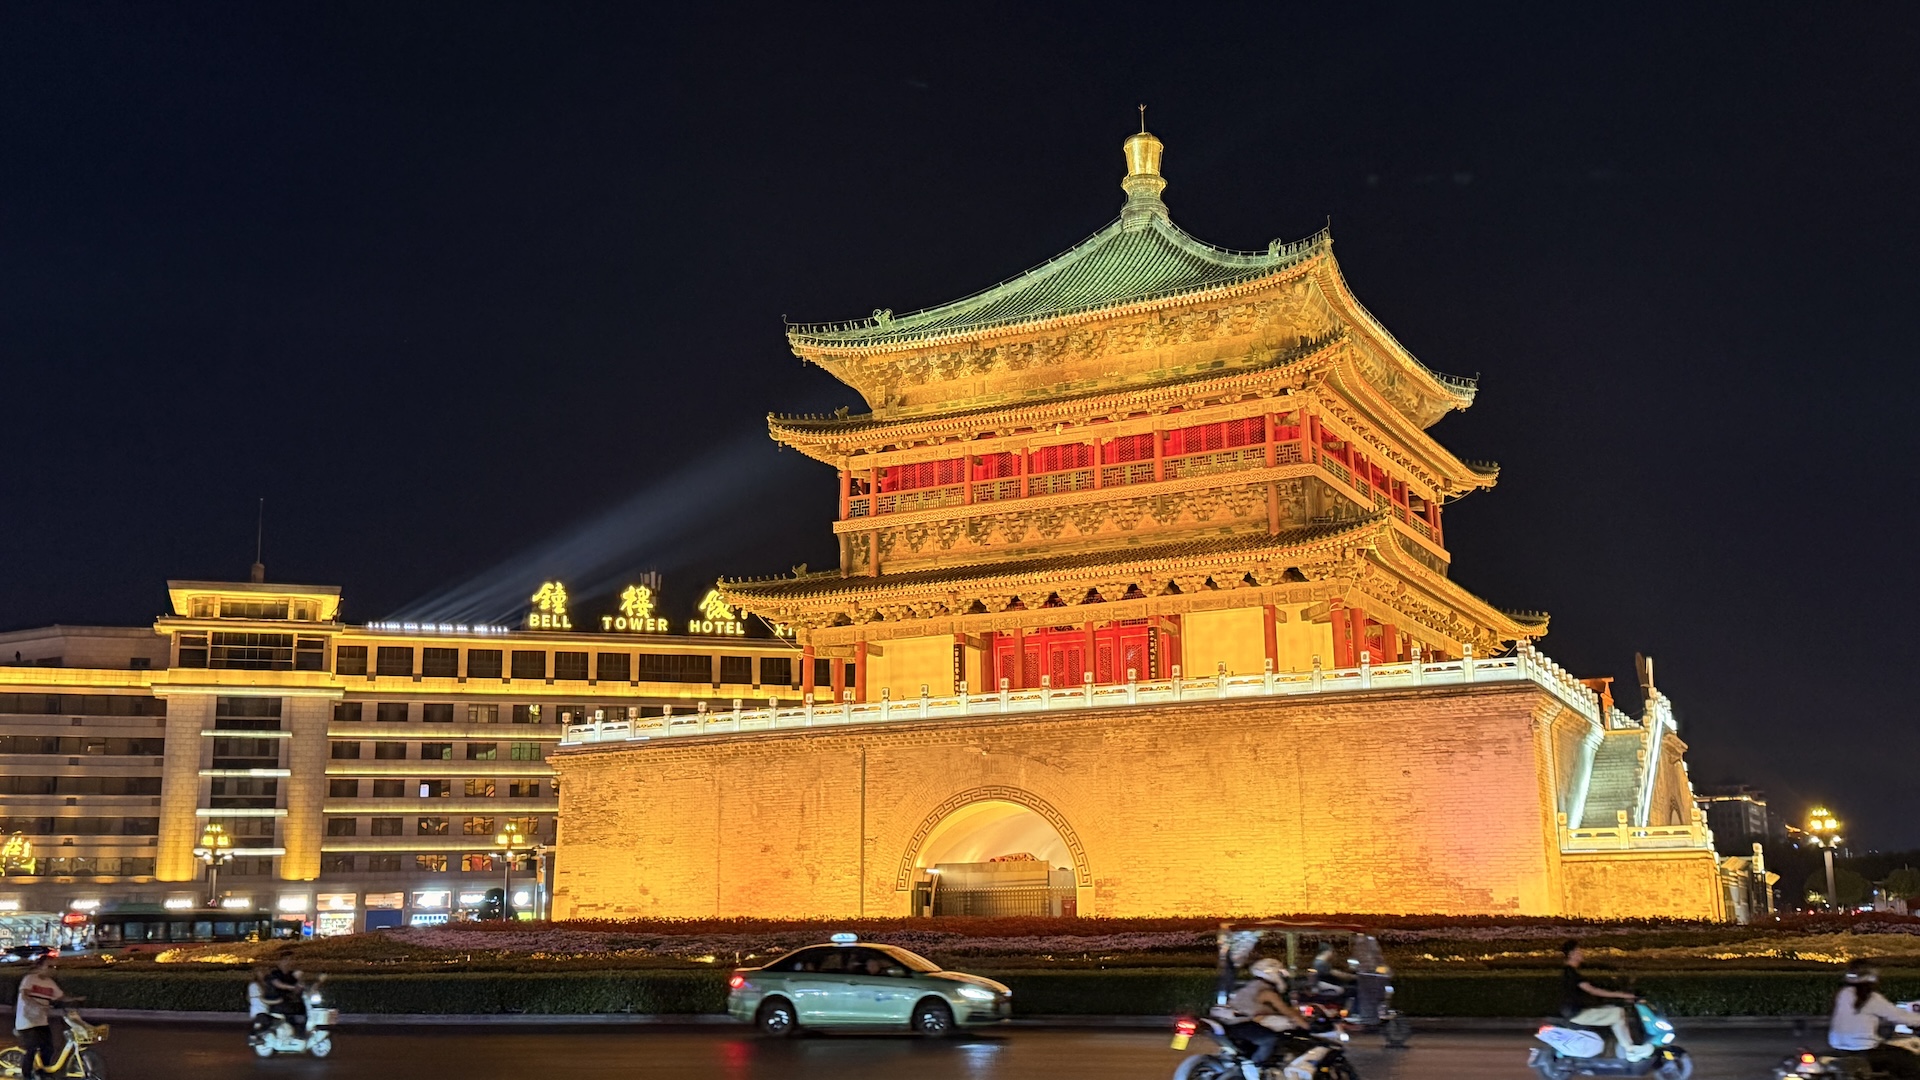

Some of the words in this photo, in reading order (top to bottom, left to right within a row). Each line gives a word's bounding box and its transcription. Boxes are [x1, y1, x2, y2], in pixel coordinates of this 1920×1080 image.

[529, 614, 572, 628] BELL
[602, 616, 668, 632] TOWER
[689, 619, 745, 635] HOTEL
